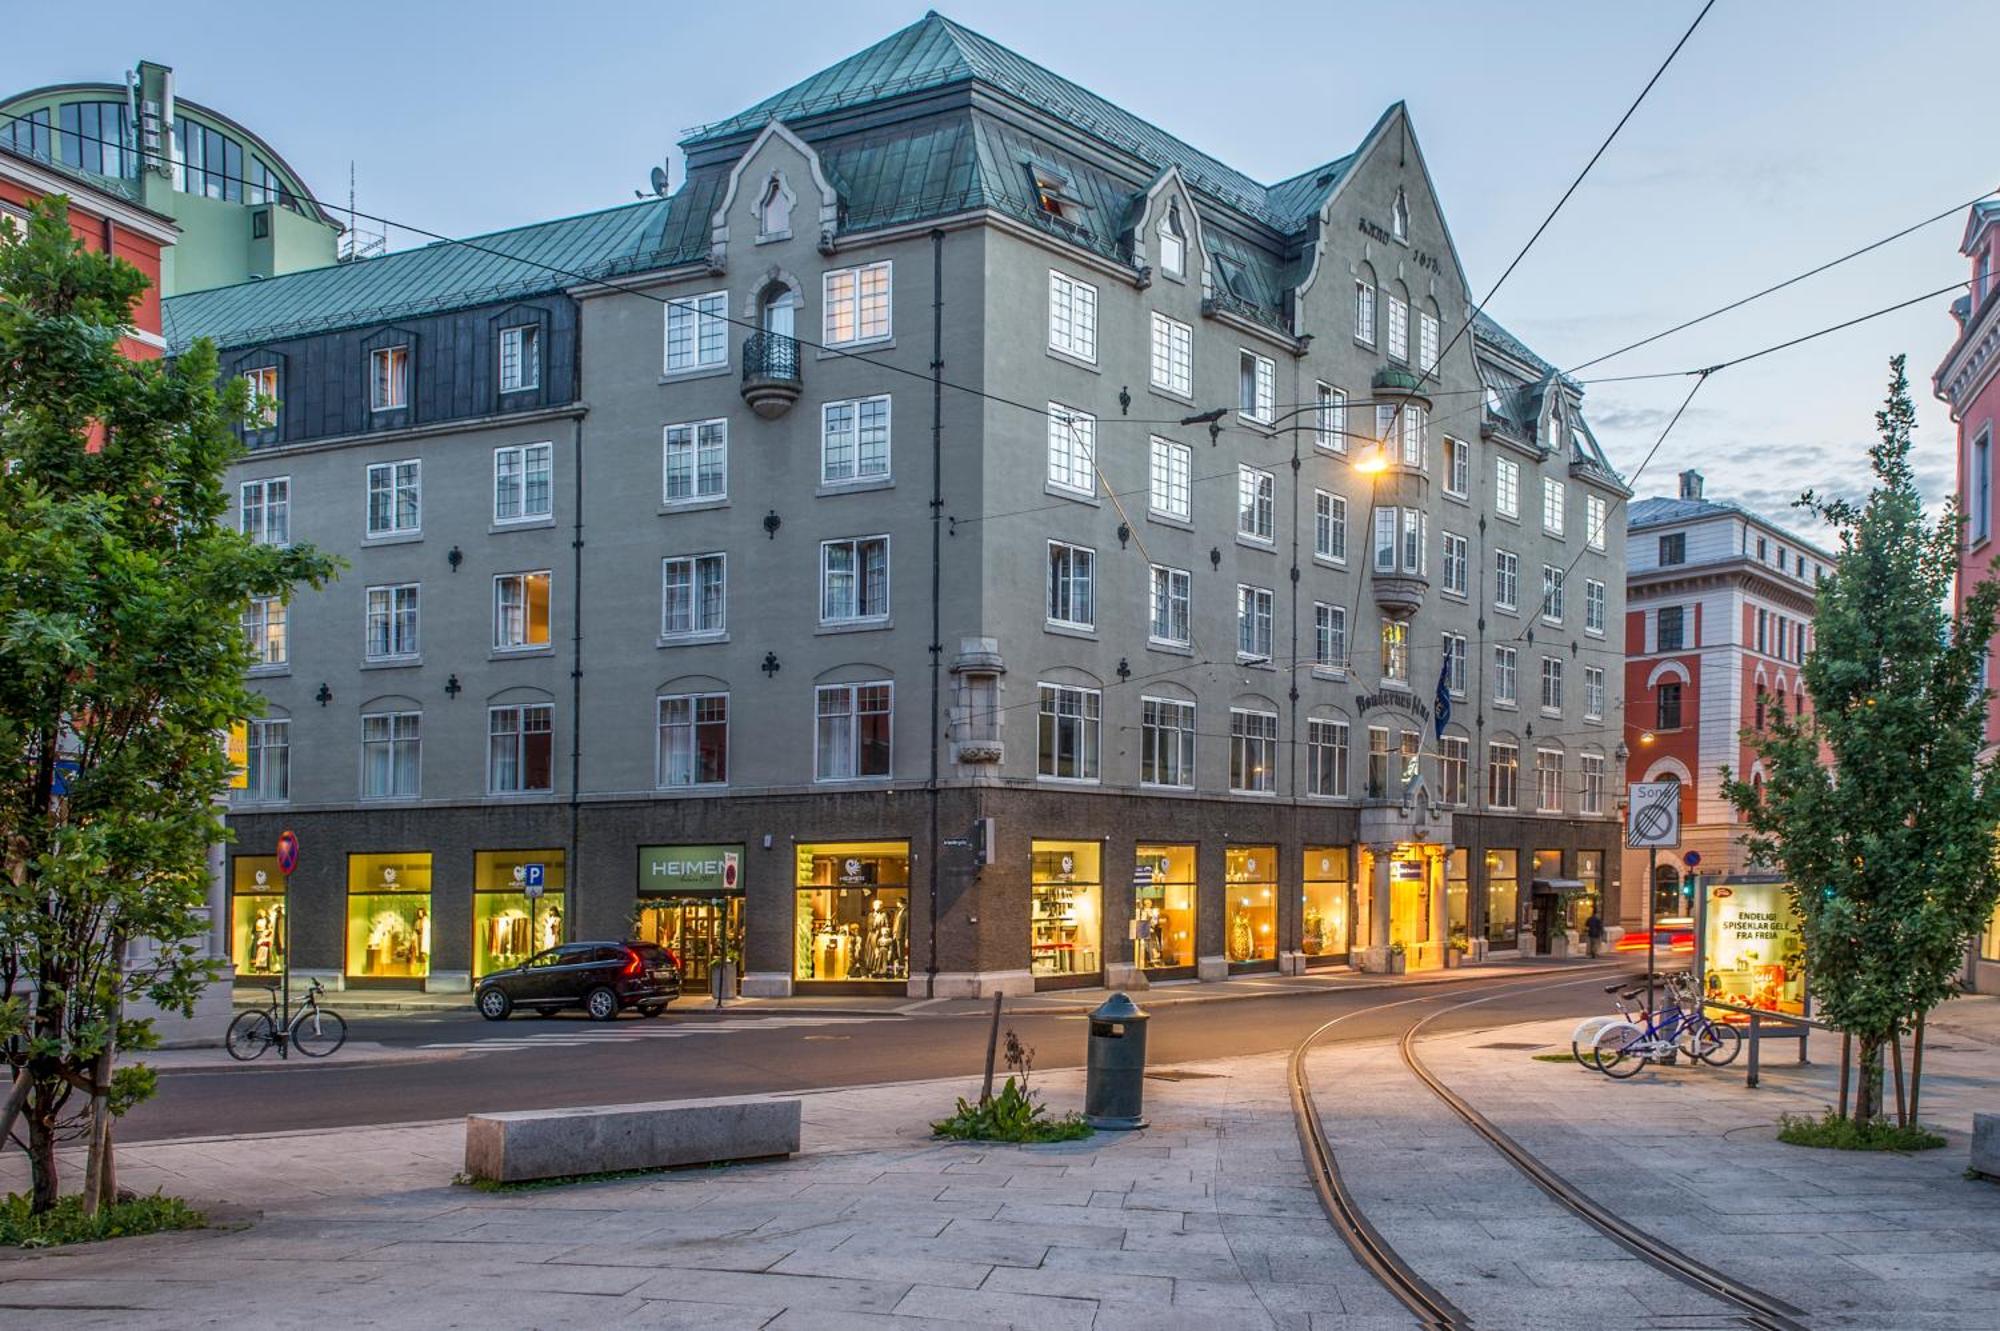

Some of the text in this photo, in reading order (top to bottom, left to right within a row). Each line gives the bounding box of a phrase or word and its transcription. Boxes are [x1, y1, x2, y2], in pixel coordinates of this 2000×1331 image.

[530, 867, 541, 884] P
[1723, 921, 1769, 930] SPISEKLAR
[1736, 931, 1778, 940] FRA FREIA
